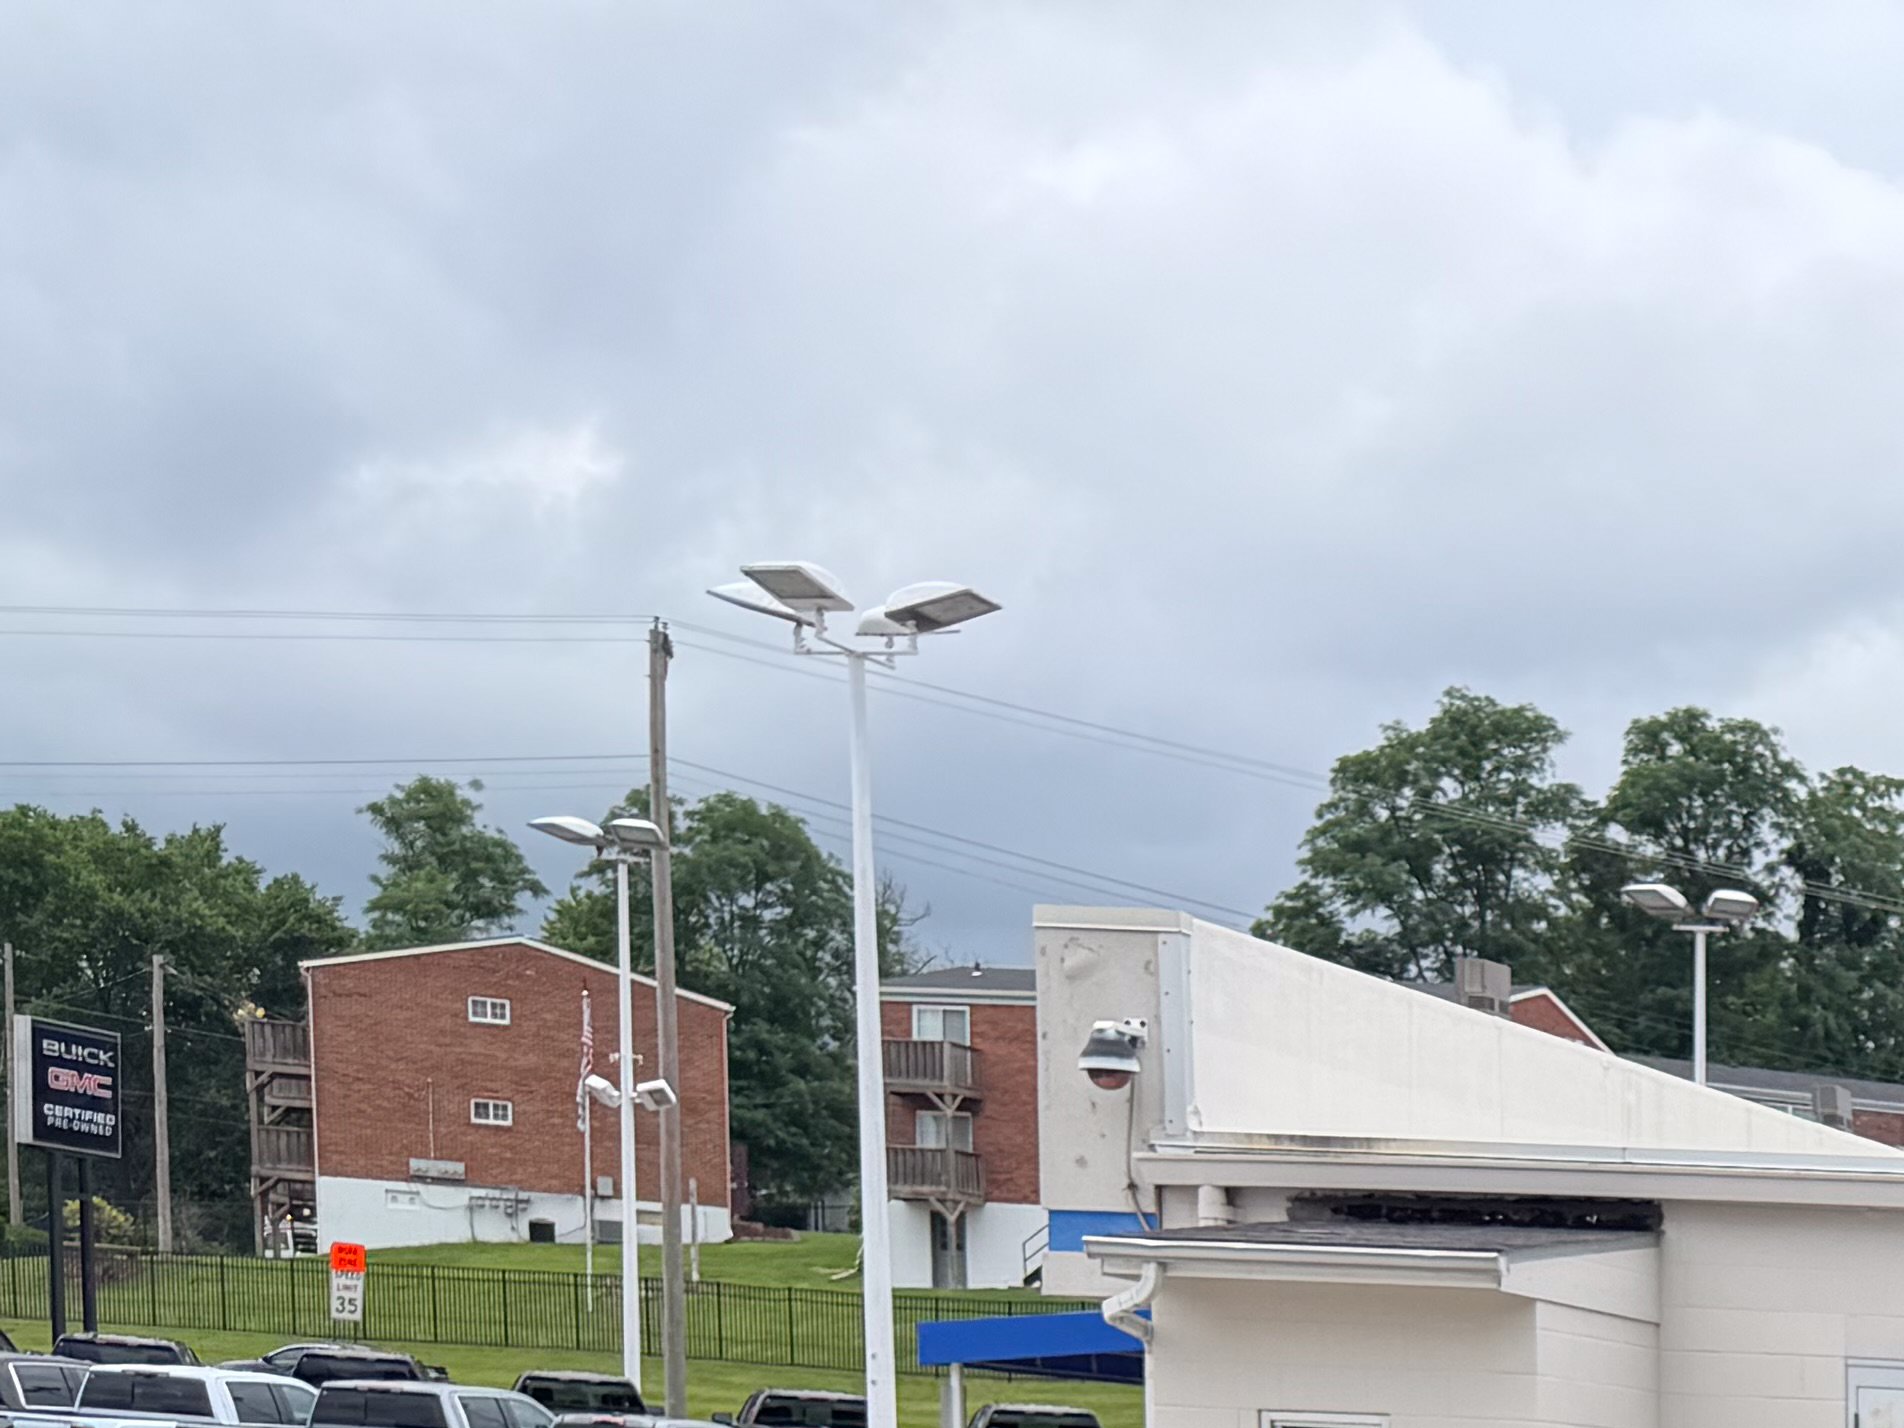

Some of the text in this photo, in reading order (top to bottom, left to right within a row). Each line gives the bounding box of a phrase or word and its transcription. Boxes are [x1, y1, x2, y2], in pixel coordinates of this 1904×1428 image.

[42, 1038, 115, 1068] BUICK
[48, 1066, 113, 1099] GMC
[43, 1103, 116, 1126] CERTIFIED
[335, 1295, 358, 1314] 35
